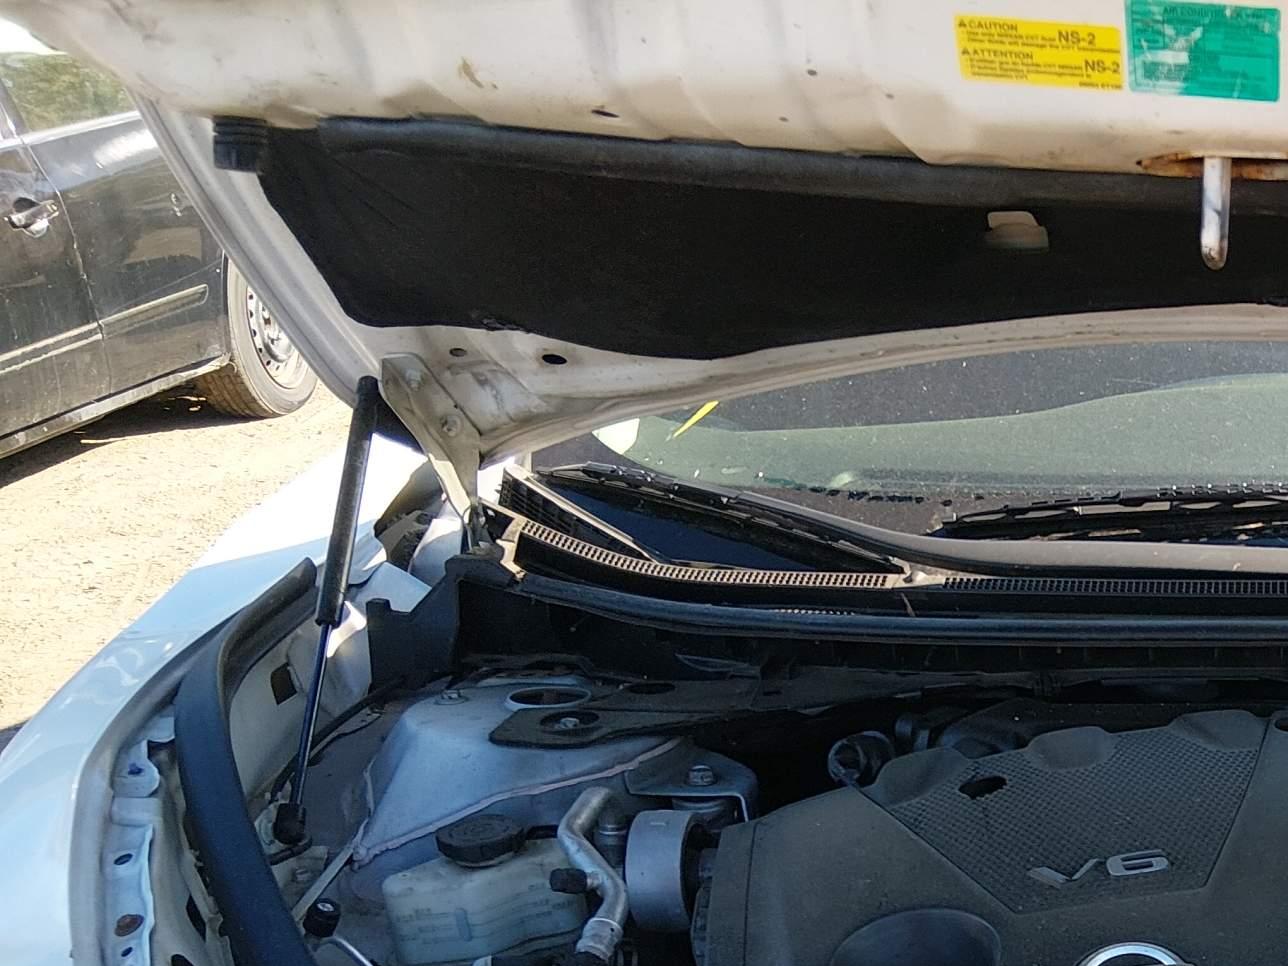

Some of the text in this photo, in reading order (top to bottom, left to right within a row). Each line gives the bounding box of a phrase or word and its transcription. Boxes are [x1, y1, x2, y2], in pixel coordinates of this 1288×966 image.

[968, 19, 1018, 32] CAUTION
[1058, 29, 1096, 47] NS-2
[972, 47, 1034, 60] ATTENTION
[1084, 58, 1121, 75] NS-2
[1028, 849, 1169, 888] V6
